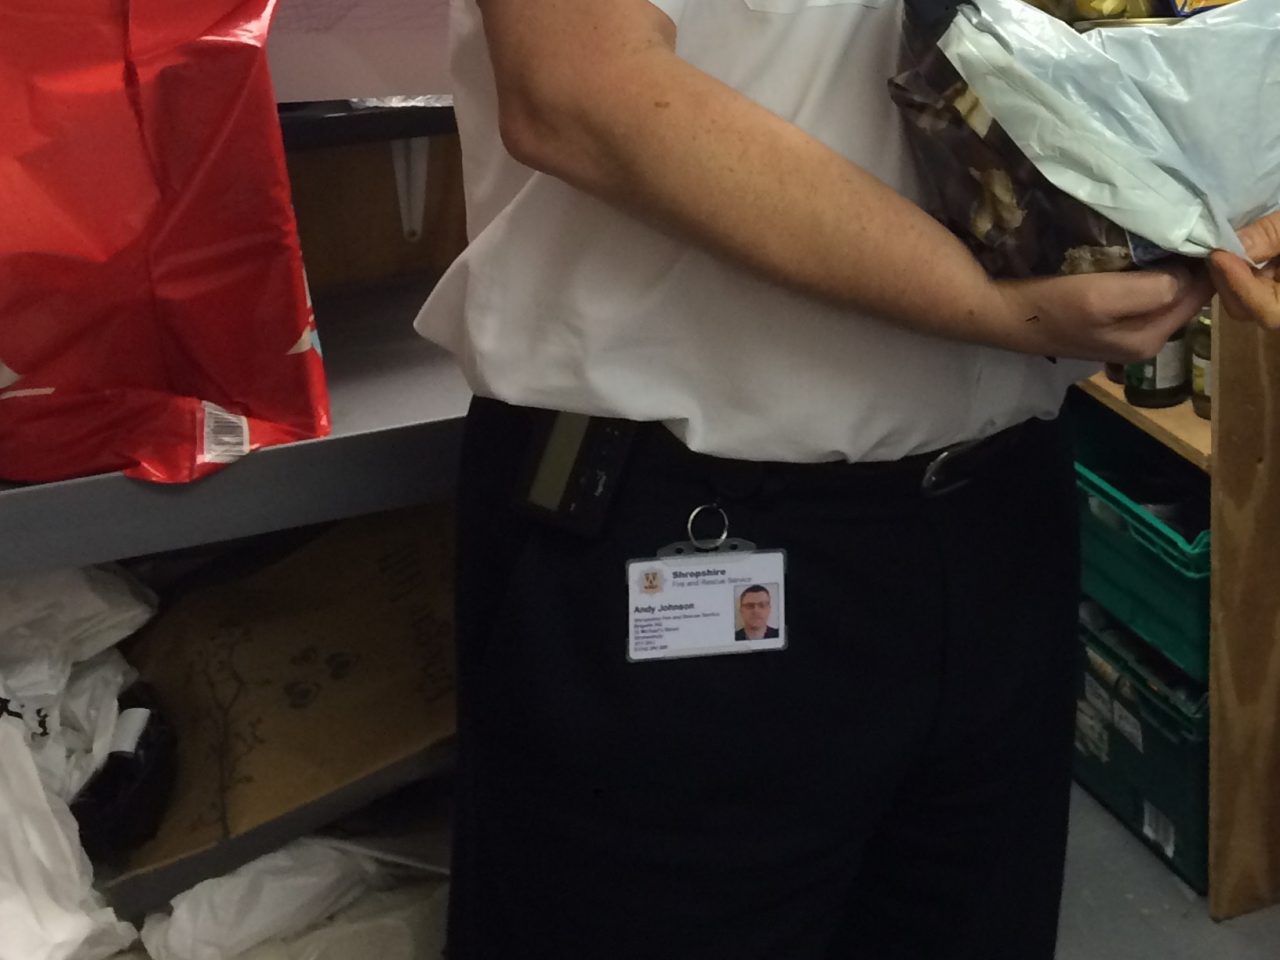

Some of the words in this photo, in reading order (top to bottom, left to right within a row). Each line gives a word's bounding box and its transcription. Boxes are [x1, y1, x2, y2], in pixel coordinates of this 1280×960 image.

[672, 568, 727, 580] Shropshire
[634, 604, 656, 616] Andy
[657, 602, 695, 614] Johnson
